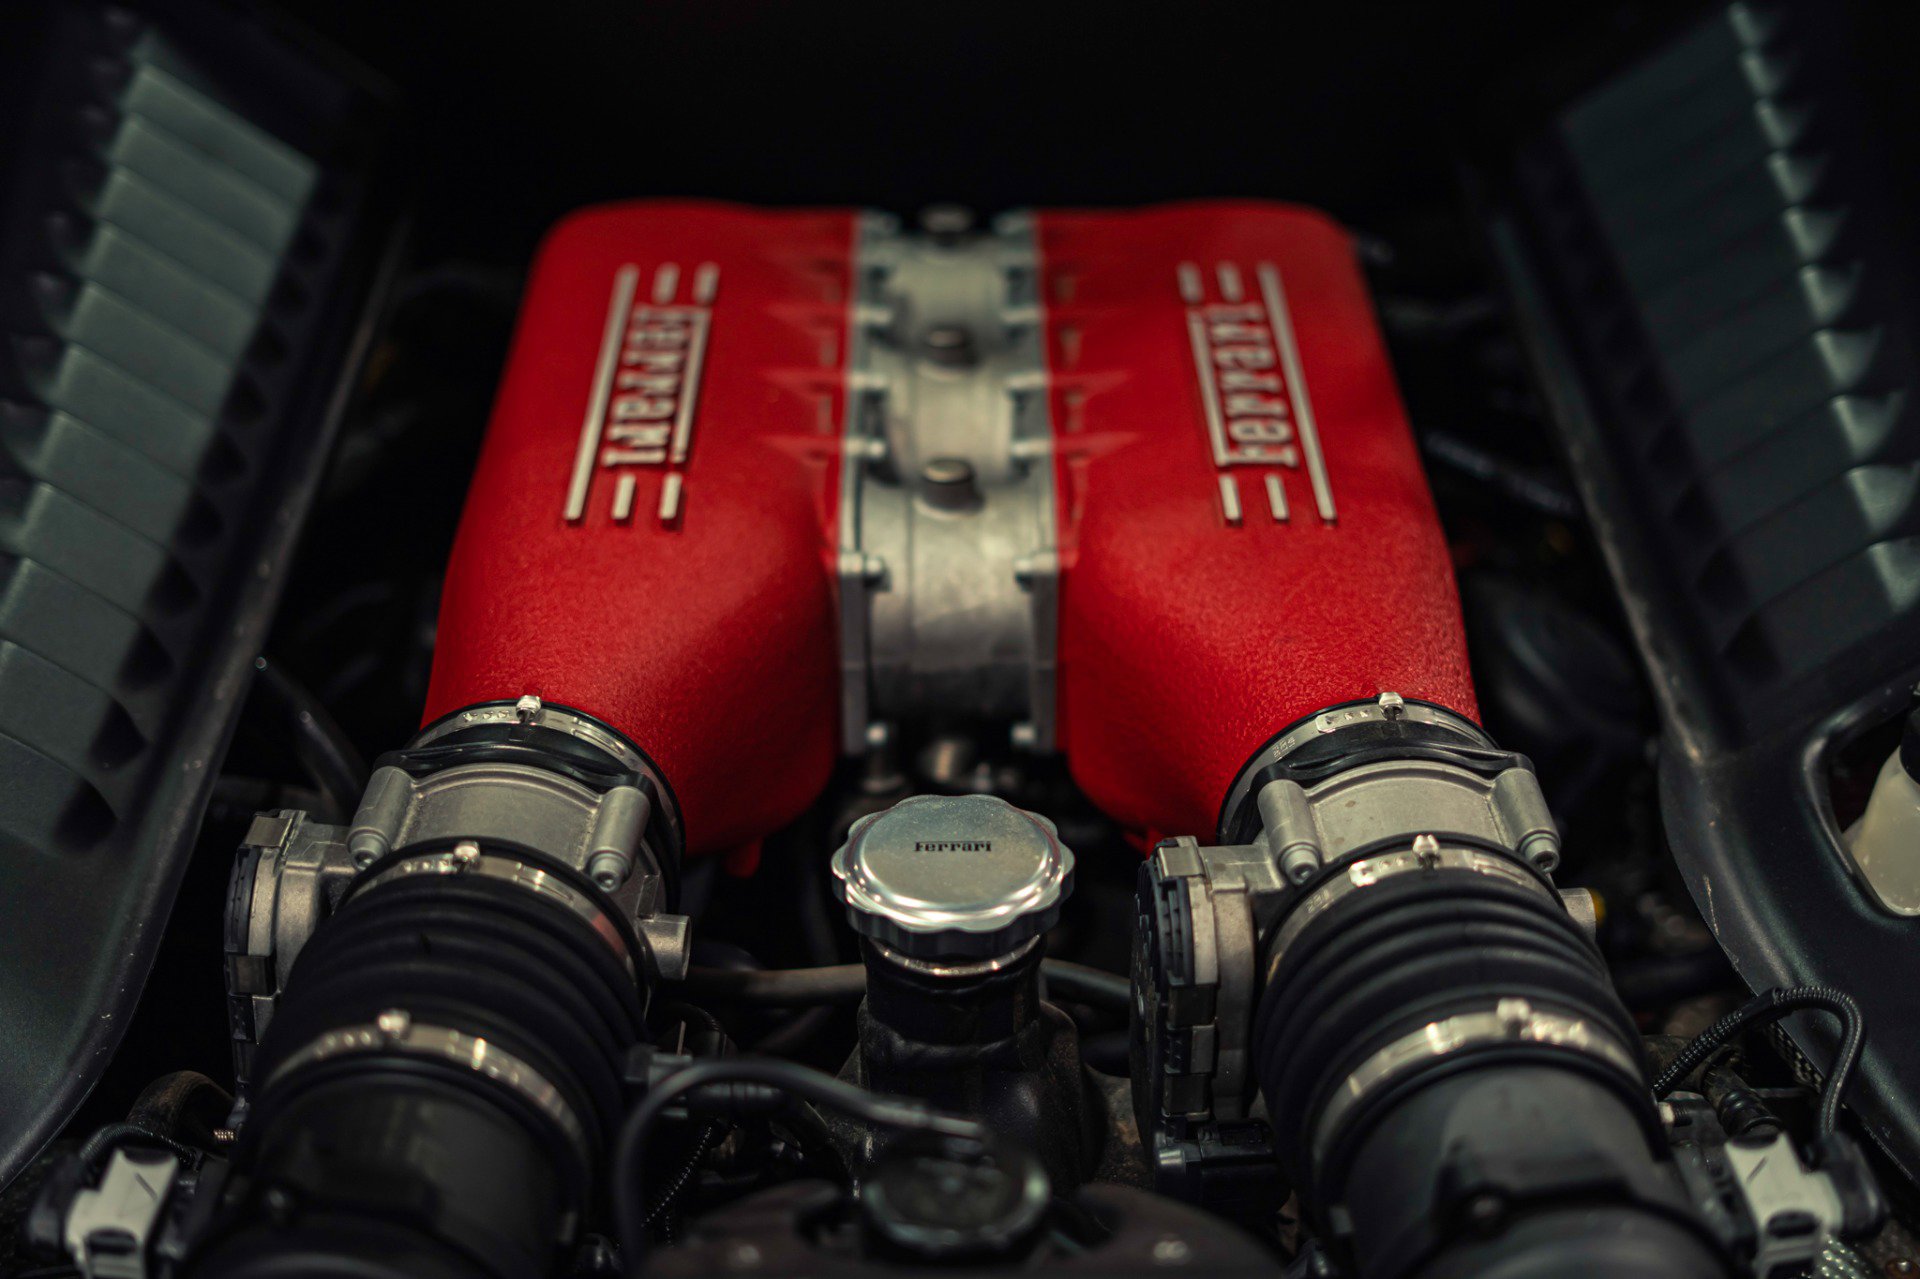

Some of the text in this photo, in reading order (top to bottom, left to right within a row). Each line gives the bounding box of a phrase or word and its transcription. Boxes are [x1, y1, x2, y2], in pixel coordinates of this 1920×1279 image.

[601, 302, 713, 467] Ferrari
[1185, 303, 1299, 468] Ferrari
[914, 841, 992, 852] Ferrari
